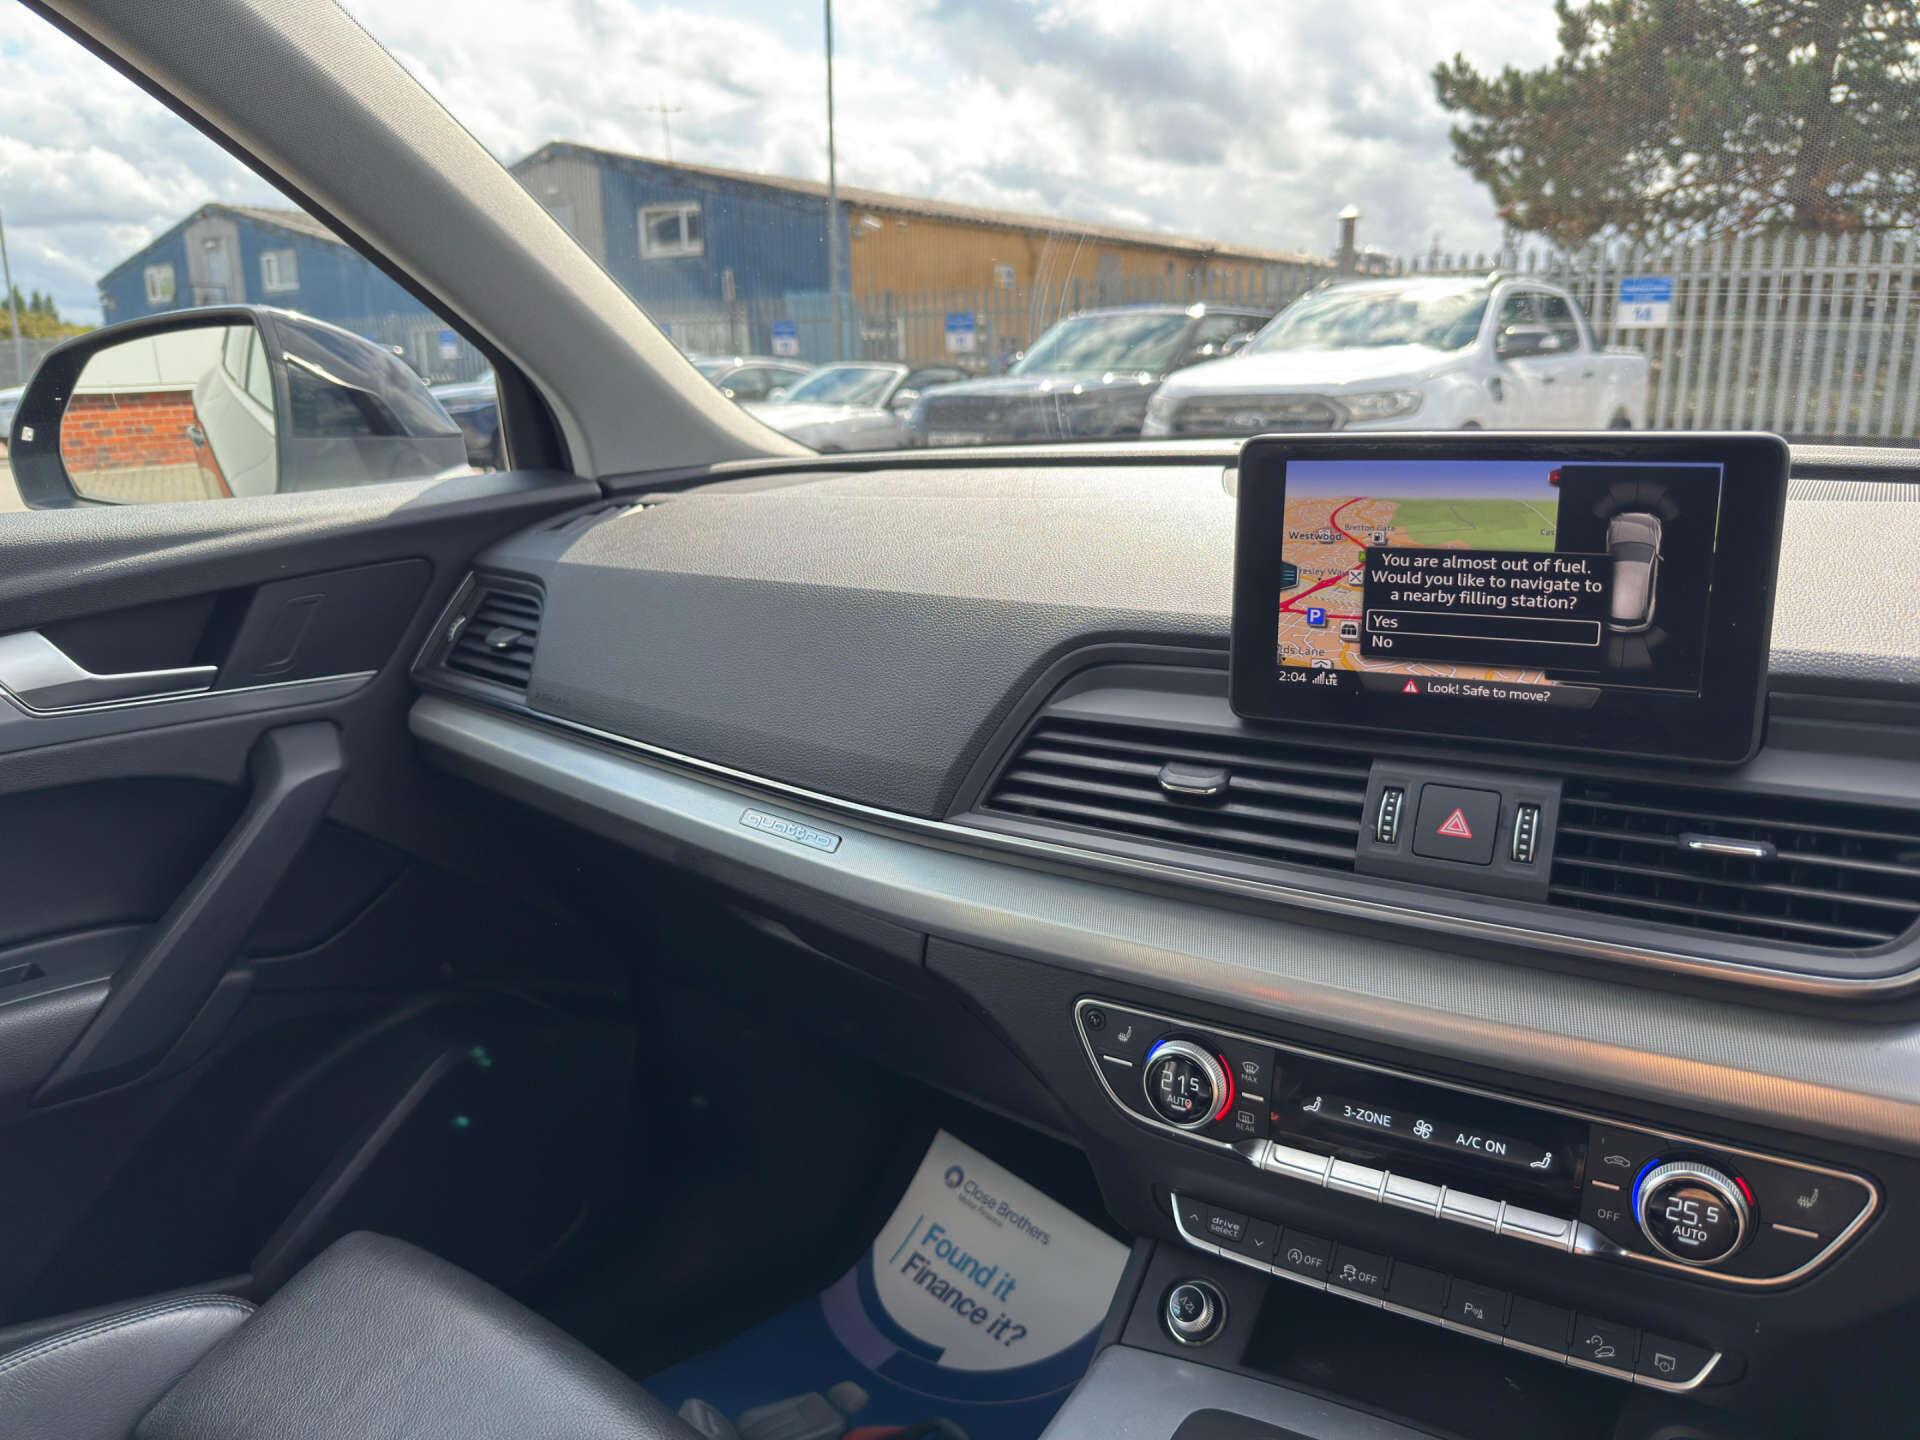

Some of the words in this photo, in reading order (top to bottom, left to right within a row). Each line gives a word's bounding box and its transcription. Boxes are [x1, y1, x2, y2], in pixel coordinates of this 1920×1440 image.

[1288, 530, 1343, 541] Westwood
[1382, 553, 1410, 567] You
[1413, 557, 1439, 568] are
[1442, 554, 1497, 570] almost
[1501, 558, 1529, 571] out
[1533, 558, 1551, 572] of
[1553, 558, 1591, 574] fuel.
[1371, 569, 1421, 584] Would
[1424, 575, 1453, 588] you
[1457, 572, 1485, 587] like
[1489, 575, 1506, 588] to
[1510, 577, 1580, 594] navigate
[1584, 578, 1602, 593] to
[1390, 591, 1399, 600] a
[1403, 589, 1456, 607] nearby
[1459, 590, 1507, 609] filling
[1511, 595, 1578, 610] station?
[1372, 614, 1398, 629] Yes
[1372, 635, 1393, 648] No
[1279, 671, 1307, 683] 2:04
[1427, 682, 1459, 696] Look!
[1462, 684, 1490, 697] Safe
[1492, 687, 1506, 699] to
[1509, 690, 1551, 702] move?
[747, 813, 832, 849] quattro
[1241, 1073, 1258, 1084] MAX
[1166, 1093, 1193, 1109] AUTO
[1343, 1104, 1392, 1128] 3-ZONE
[1235, 1121, 1256, 1134] REAR
[1455, 1132, 1481, 1150] A/C
[1485, 1140, 1507, 1155] ON
[963, 1179, 998, 1209] Close
[996, 1200, 1050, 1245] Brothers
[1596, 1207, 1621, 1222] OFF
[1665, 1196, 1720, 1228] 25.5
[1210, 1223, 1239, 1238] select
[1211, 1215, 1241, 1231] drive
[1672, 1224, 1708, 1241] AUTO
[920, 1222, 999, 1289] Found
[991, 1271, 1017, 1302] it
[1303, 1254, 1325, 1268] OFF
[1358, 1271, 1379, 1285] OFF
[900, 1250, 989, 1325] Finance
[985, 1312, 1028, 1348] it?
